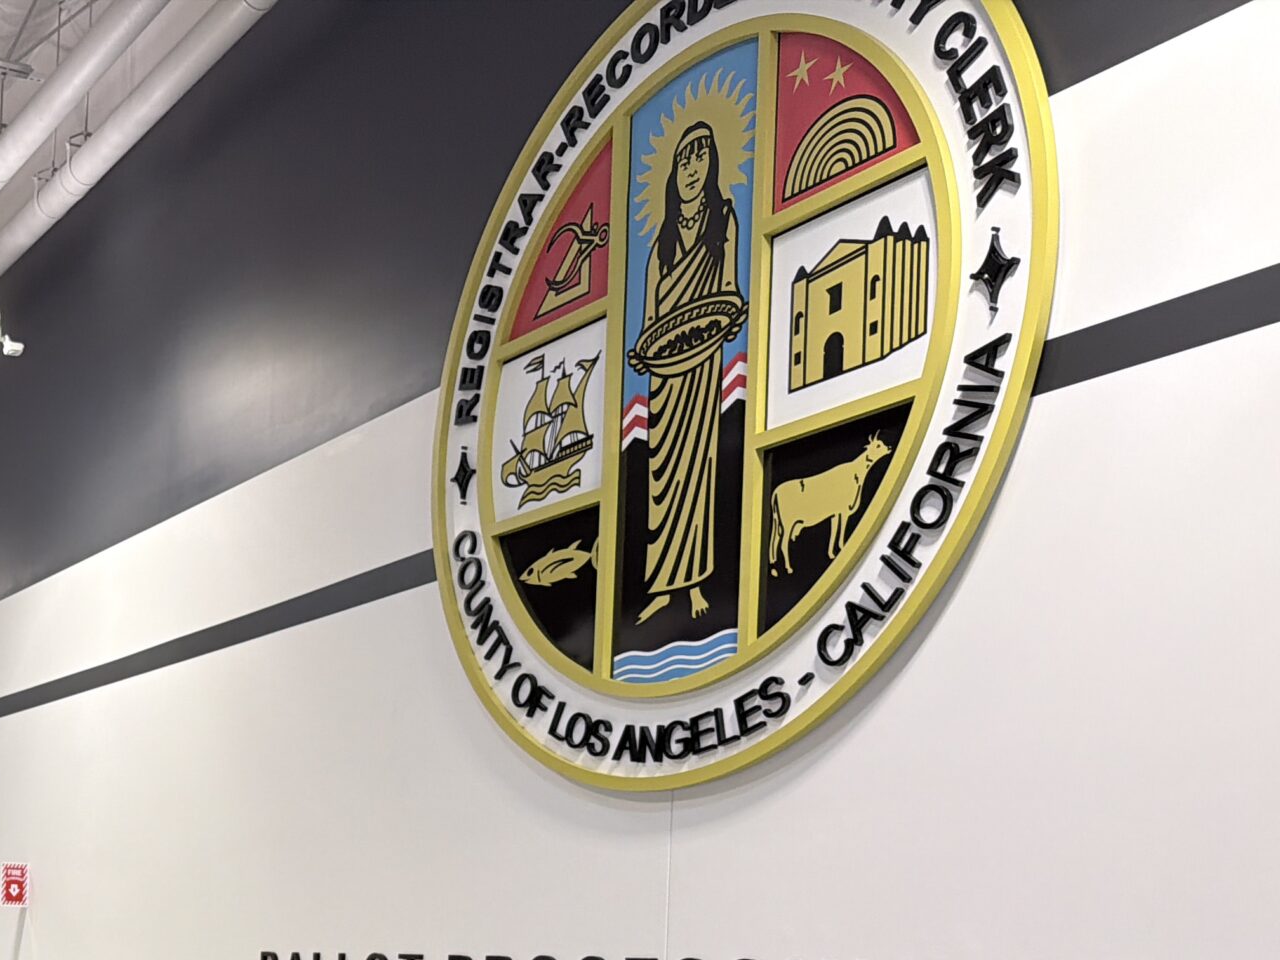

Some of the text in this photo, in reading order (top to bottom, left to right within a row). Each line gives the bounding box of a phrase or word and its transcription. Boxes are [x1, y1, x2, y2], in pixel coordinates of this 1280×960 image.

[454, 0, 1022, 426] REGISTRAR-RECORD CLERK
[453, 530, 521, 680] COUNTY
[511, 673, 555, 718] OF
[548, 701, 613, 757] LOS
[612, 676, 791, 763] ANGELES
[817, 332, 1012, 666] CALIFORNIA
[7, 868, 23, 877] FIRE
